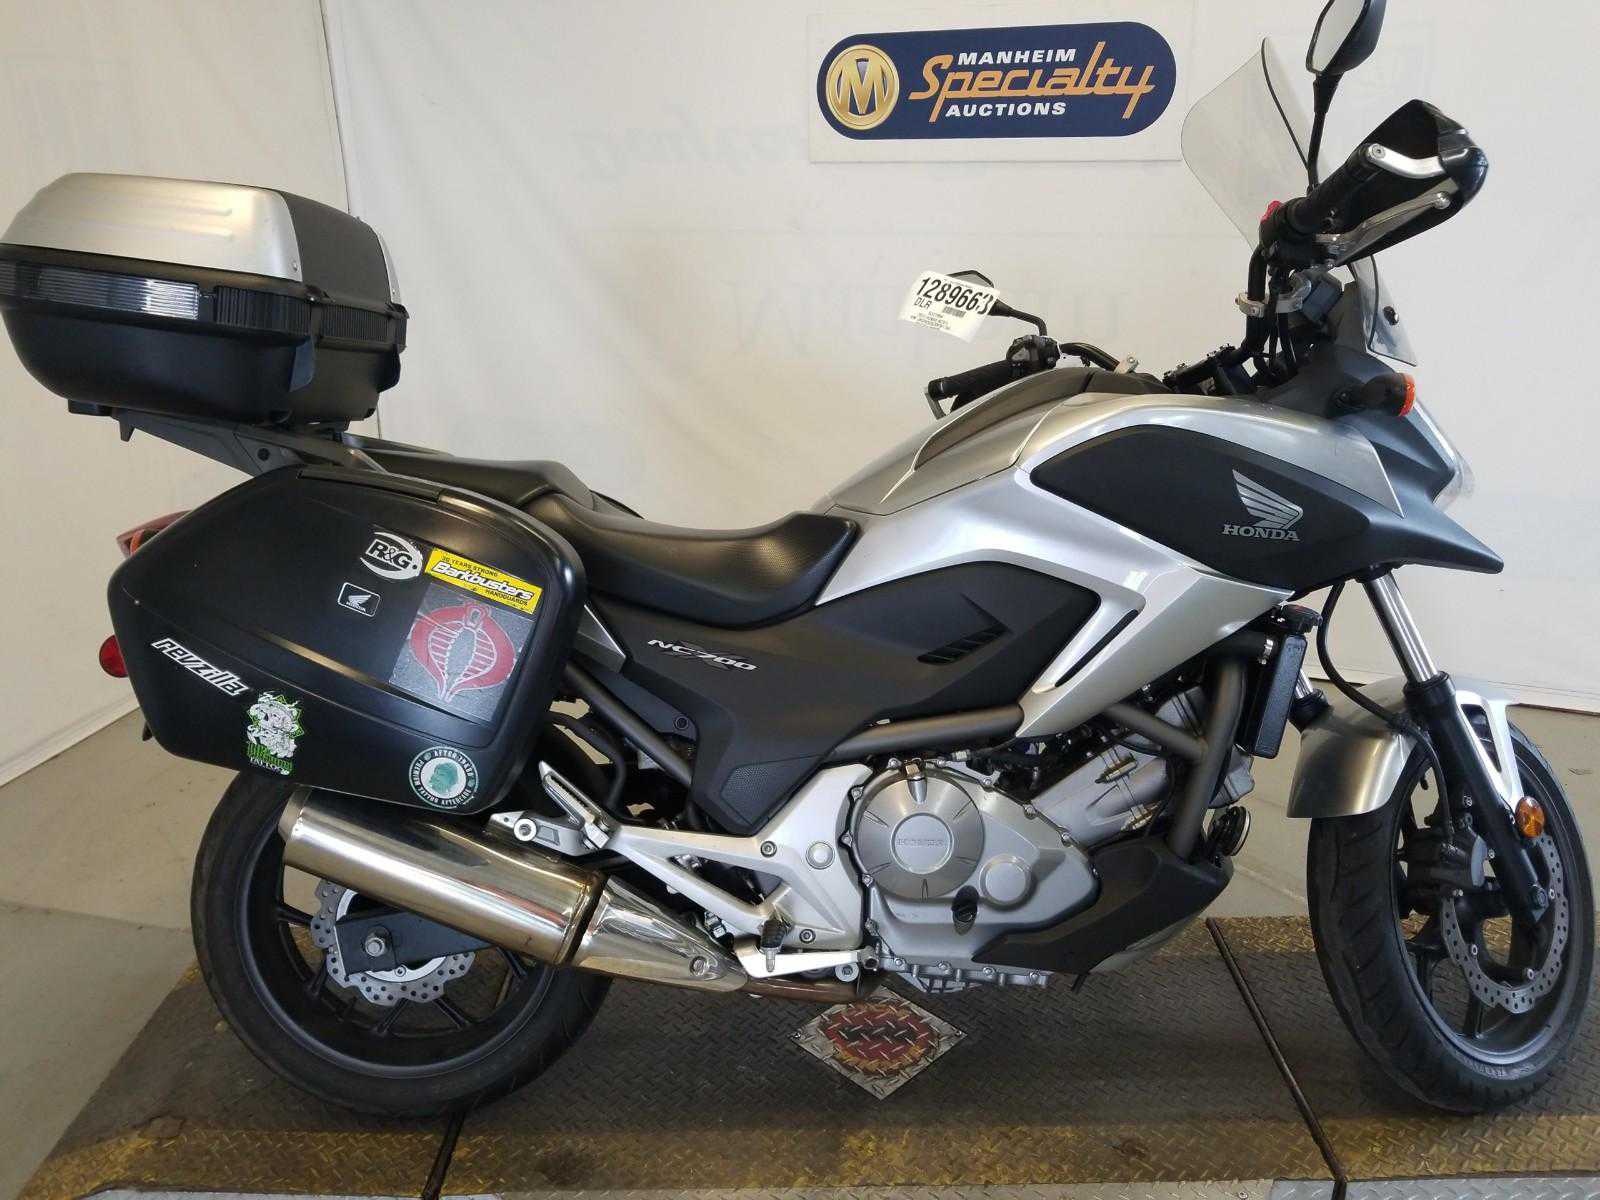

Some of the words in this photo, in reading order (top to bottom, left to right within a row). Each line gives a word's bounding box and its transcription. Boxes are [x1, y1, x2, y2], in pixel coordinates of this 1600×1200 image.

[958, 48, 1076, 66] MANHEIM
[908, 41, 1156, 123] Specialty
[945, 101, 1067, 118] AUCTIONS
[914, 297, 933, 309] DLR
[916, 277, 994, 315] 1289663
[1222, 523, 1300, 541] HONDA
[370, 541, 414, 570] R&G
[451, 558, 472, 569] YEARS
[472, 564, 499, 577] STRONG
[431, 560, 535, 600] Barkbusters
[485, 588, 529, 606] HANDGUARDS
[647, 639, 757, 671] NC700
[151, 637, 250, 697] revzilla
[434, 750, 457, 759] AFTER
